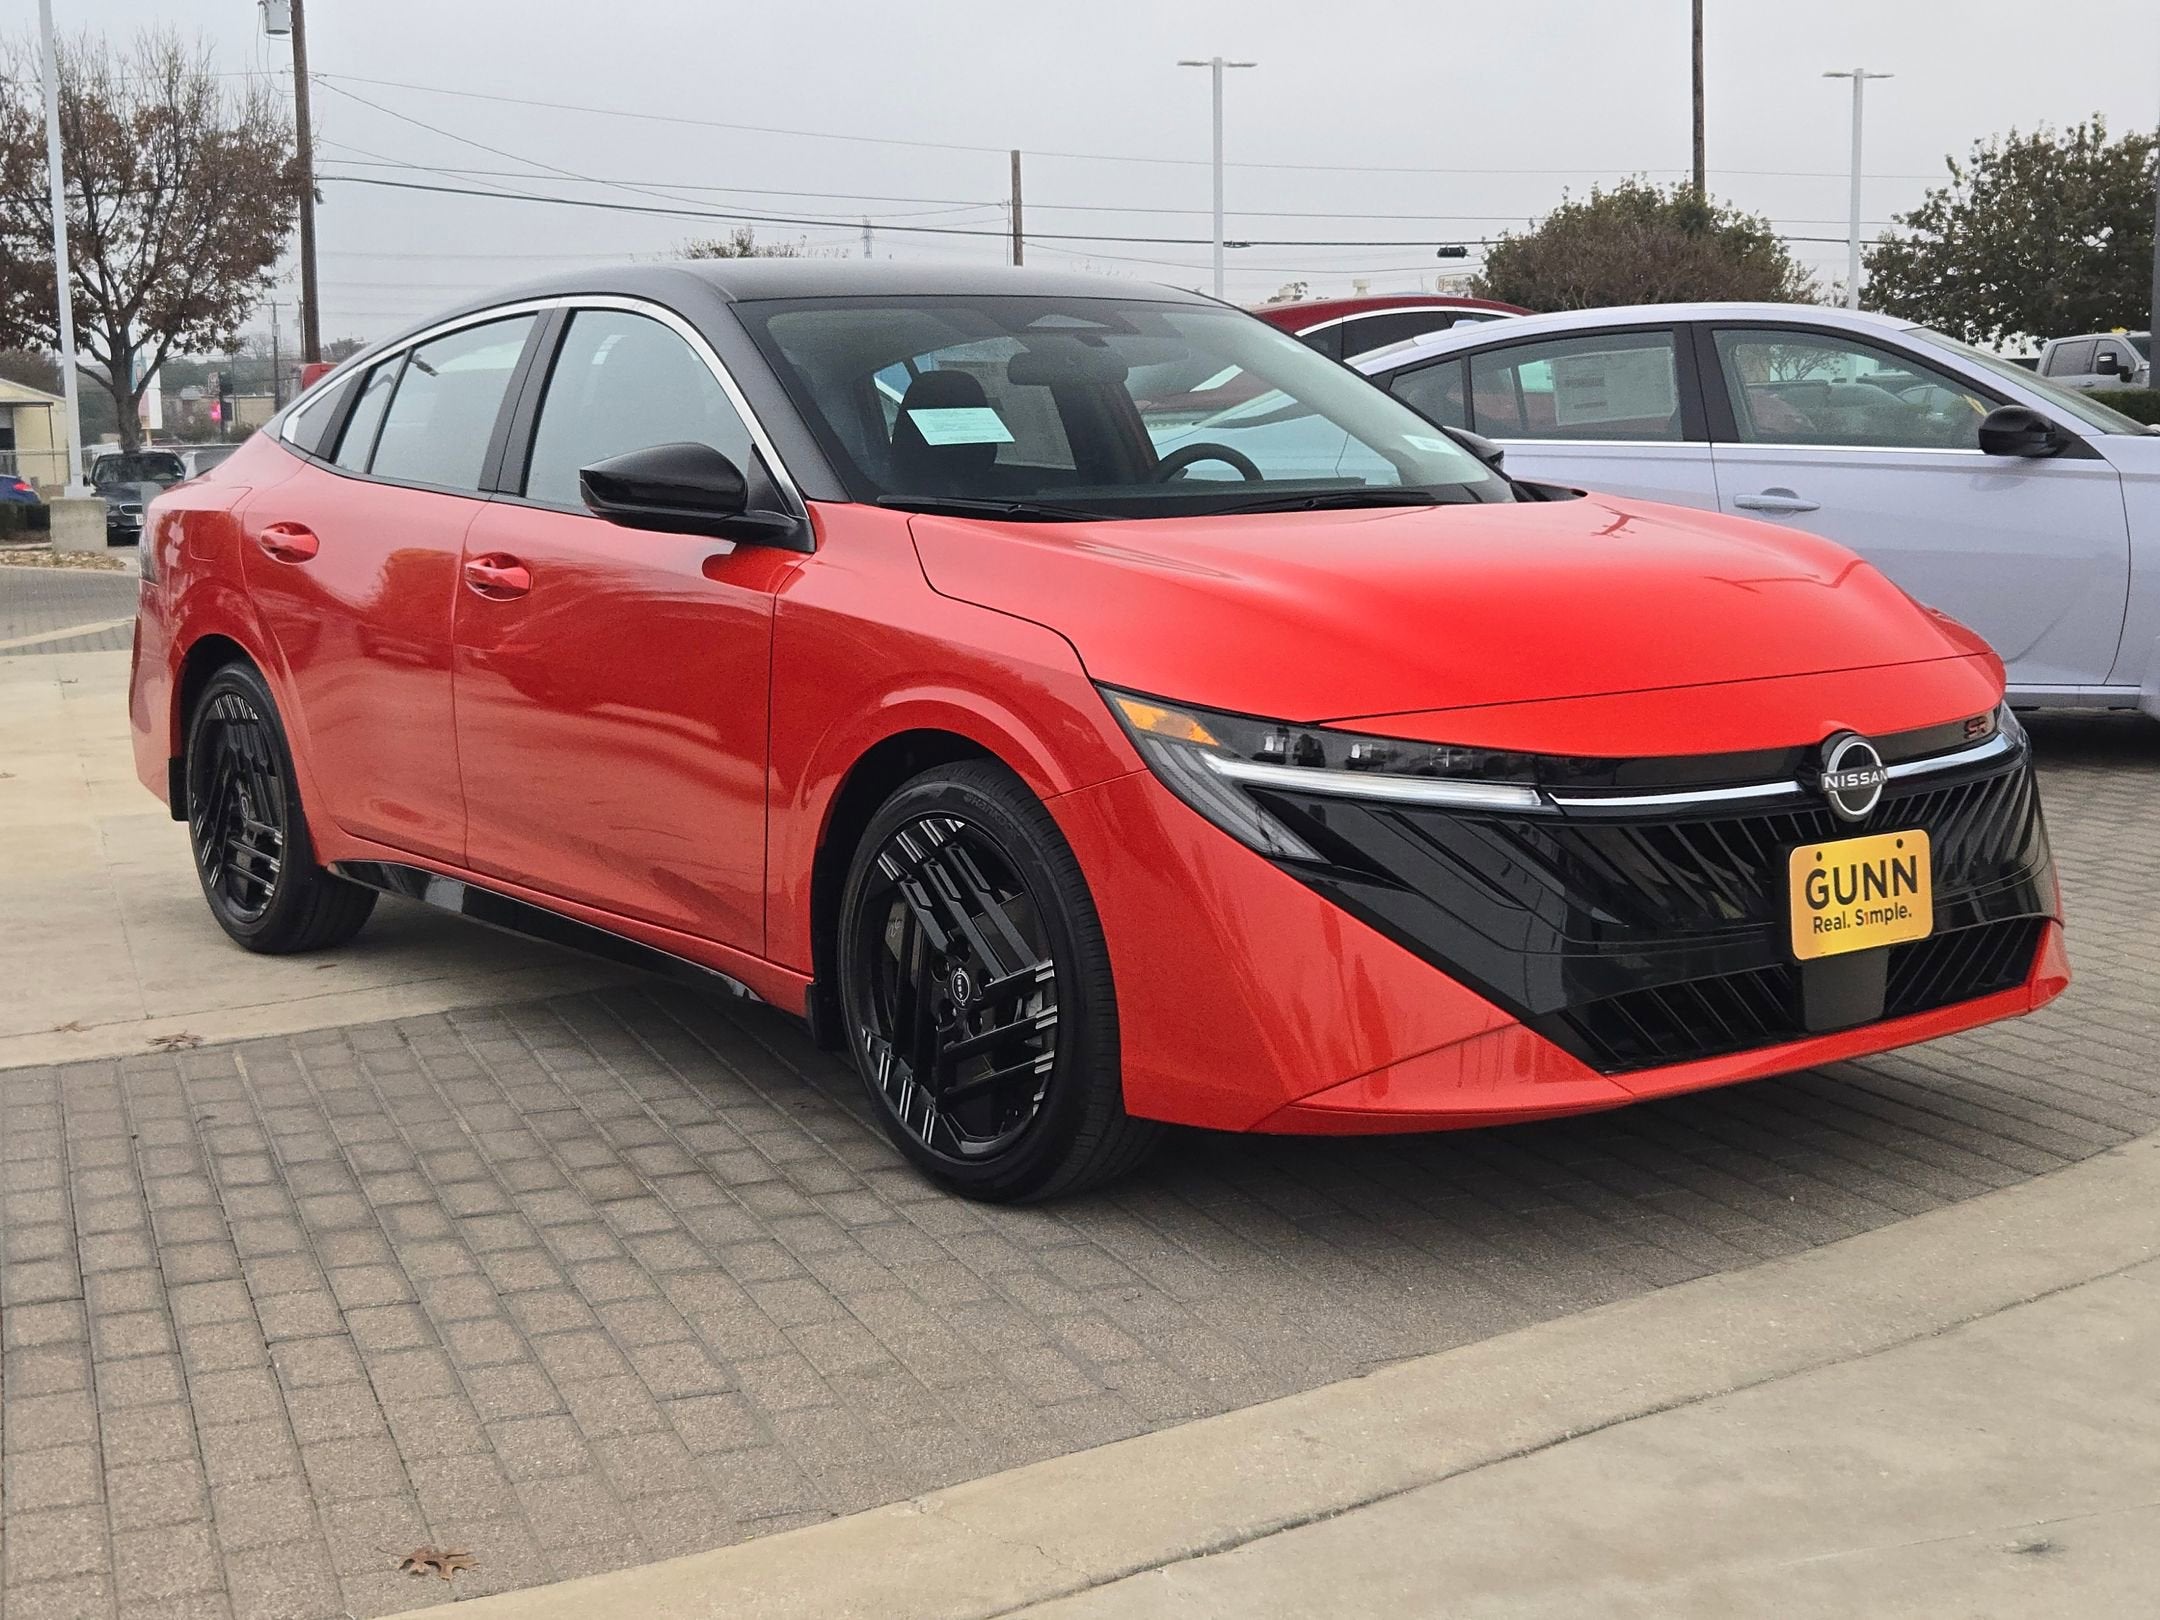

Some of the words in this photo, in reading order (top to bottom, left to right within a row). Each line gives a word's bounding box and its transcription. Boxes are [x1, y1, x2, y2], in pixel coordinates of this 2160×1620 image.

[1824, 769, 1888, 789] NISSAN
[1805, 855, 1918, 910] GUNN
[1813, 911, 1851, 934] Real.
